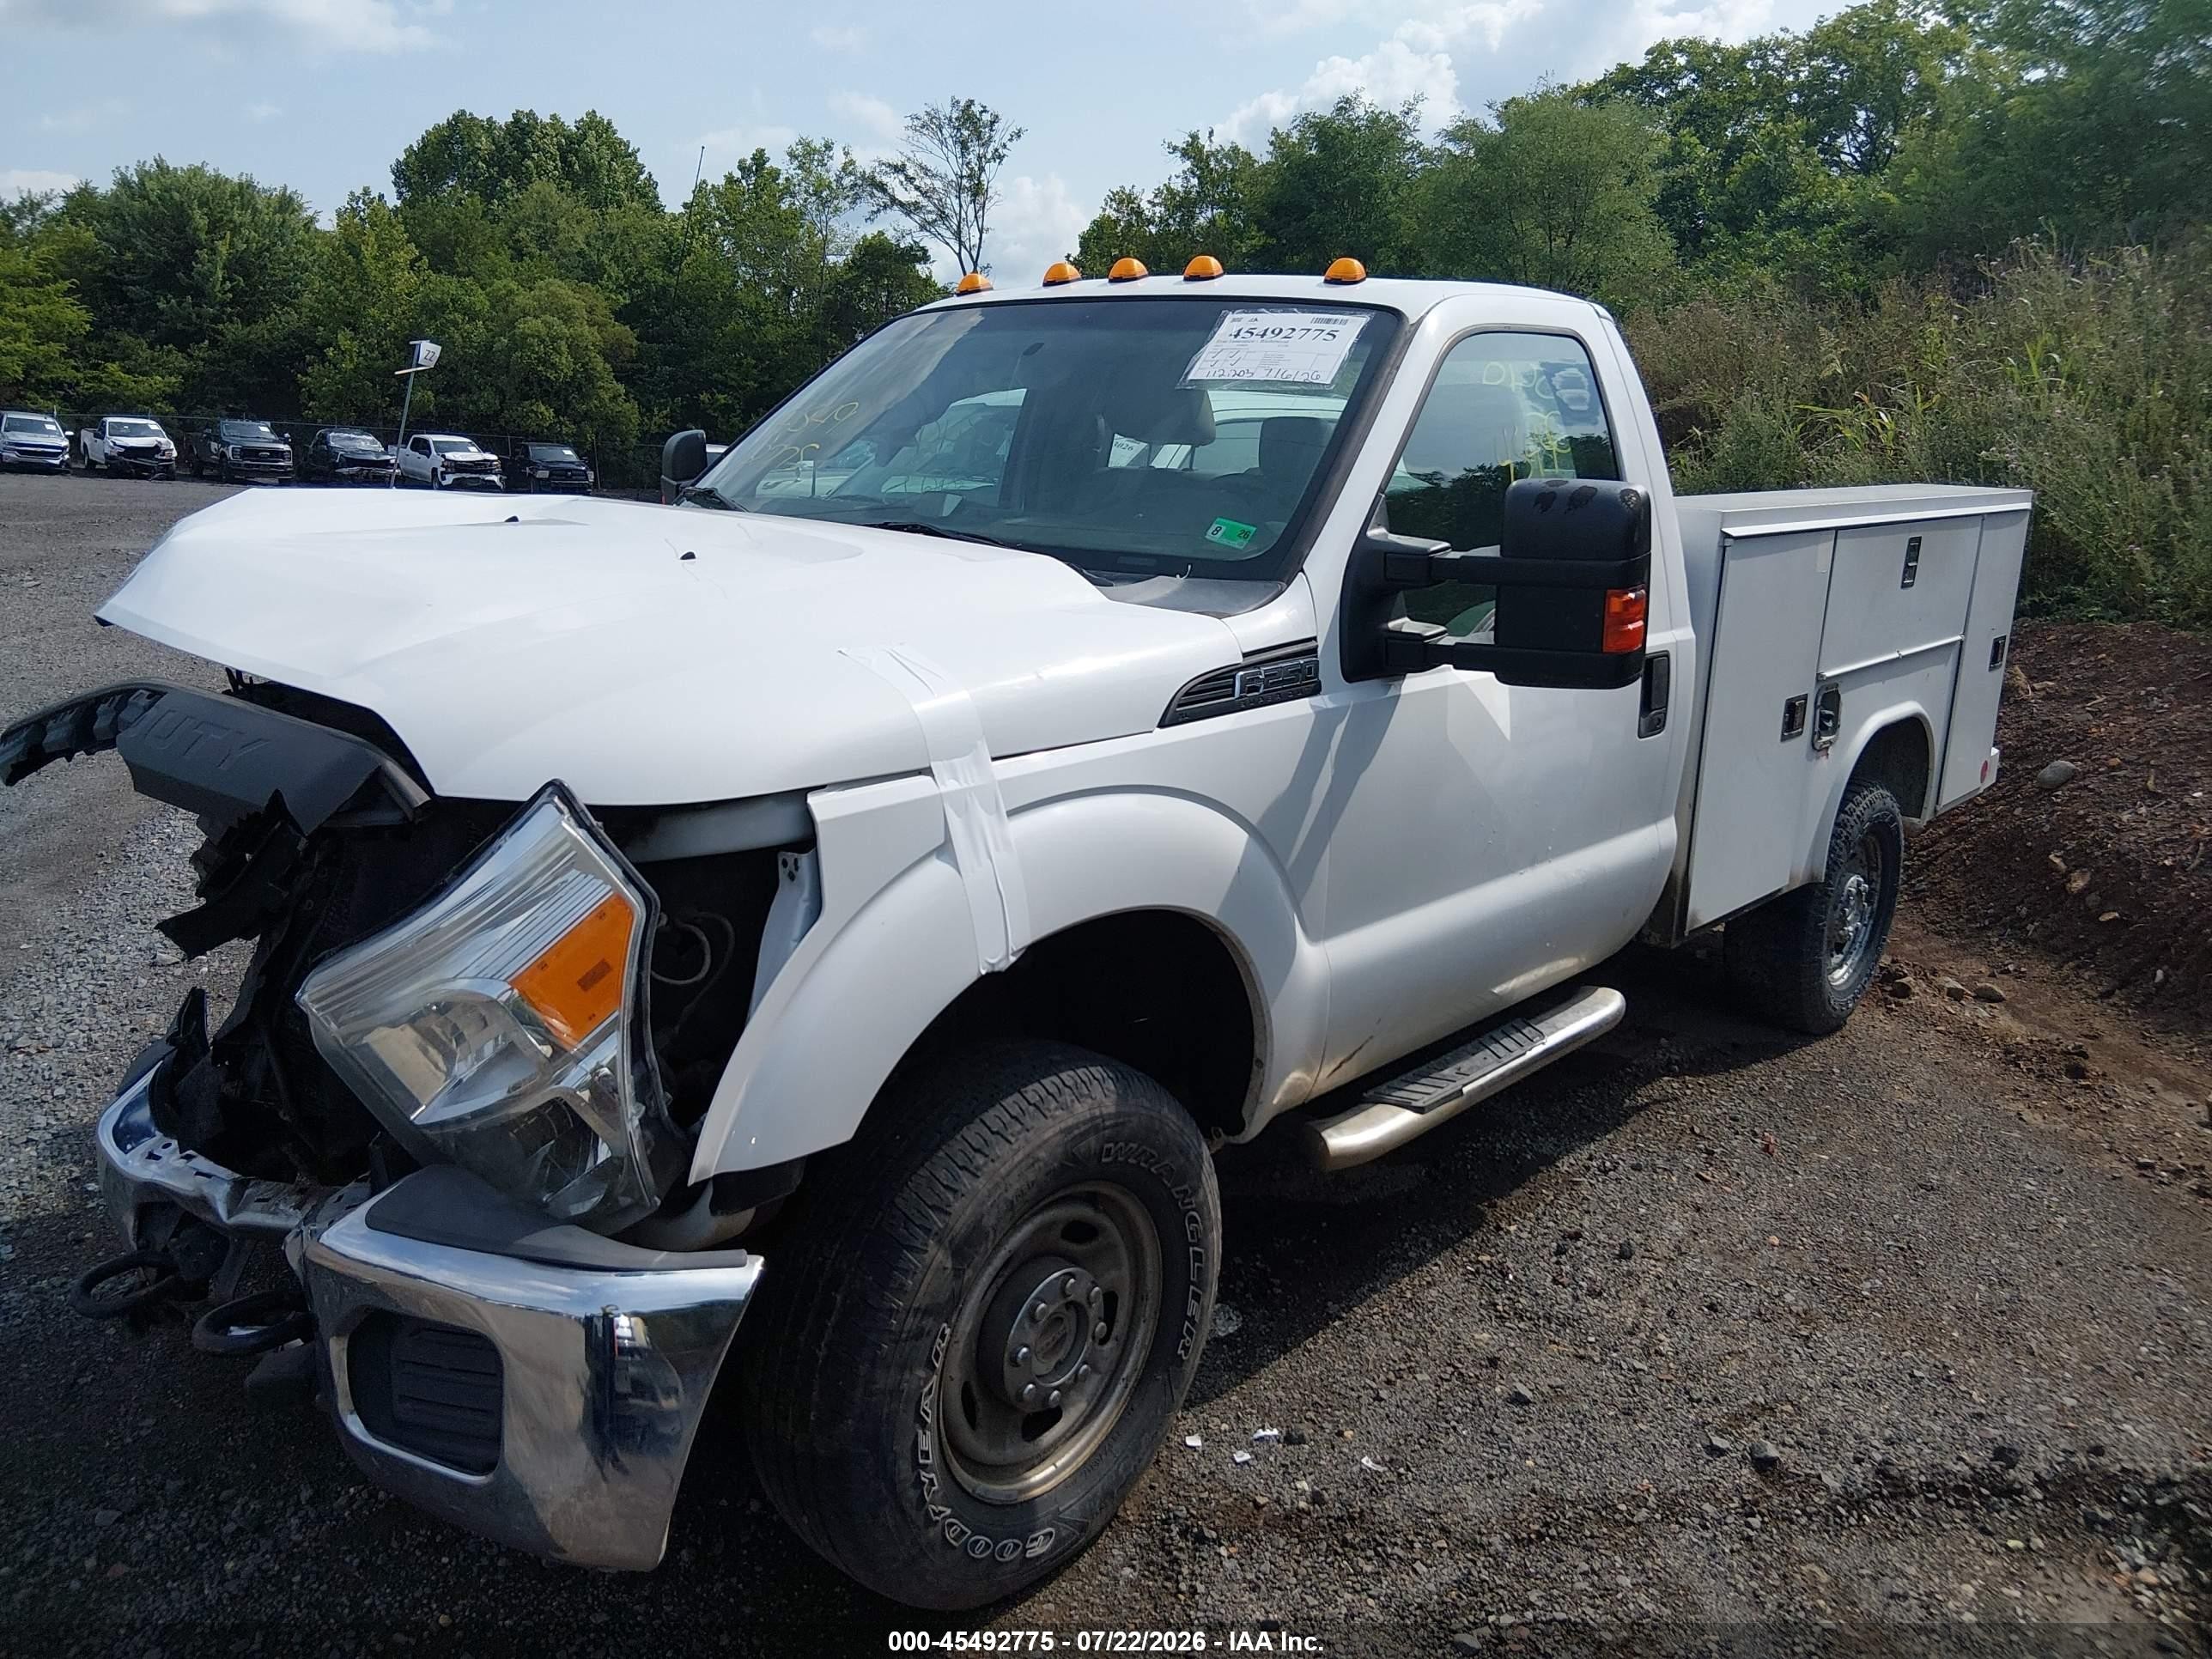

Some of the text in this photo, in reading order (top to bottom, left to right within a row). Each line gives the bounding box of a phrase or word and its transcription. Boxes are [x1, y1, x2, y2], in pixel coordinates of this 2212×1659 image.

[1229, 326, 1340, 342] 45492775
[423, 349, 436, 362] 22
[1211, 526, 1251, 539] 8 26
[1101, 1141, 1204, 1363] WRANGLER
[917, 1322, 1055, 1562] GOODYEAR
